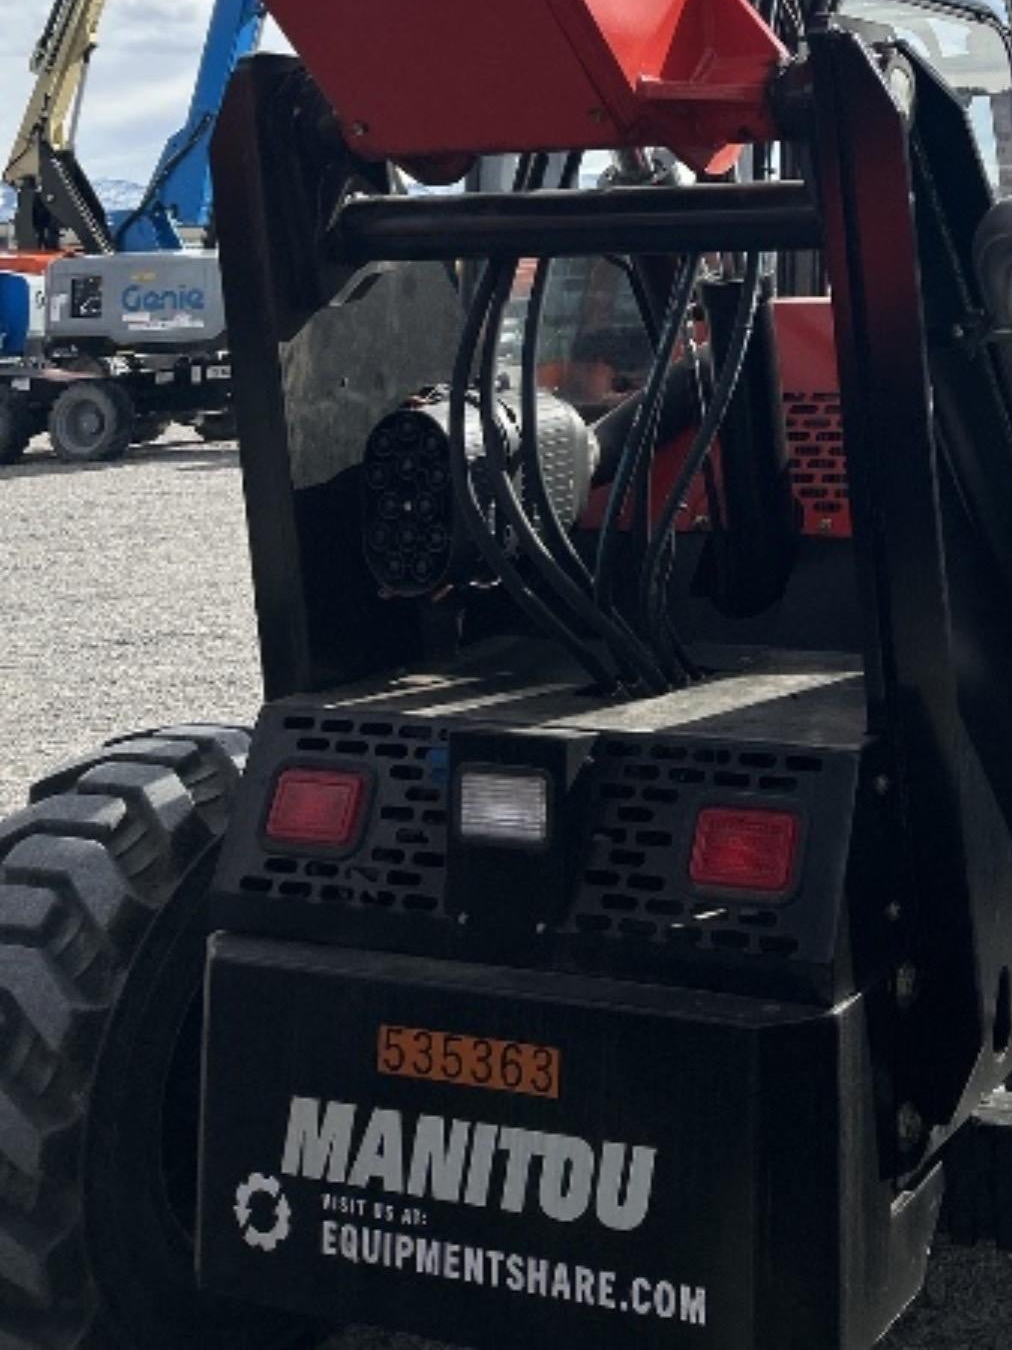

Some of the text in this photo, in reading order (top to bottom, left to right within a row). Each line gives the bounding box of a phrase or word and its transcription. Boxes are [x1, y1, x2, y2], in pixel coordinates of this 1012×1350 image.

[122, 284, 205, 311] Genie
[383, 1028, 554, 1093] 535363
[281, 1096, 656, 1230] MANITOU
[320, 1193, 367, 1217] VISIT
[373, 1202, 394, 1221] US
[321, 1221, 707, 1325] EQUIPMENTSHARE.COM
